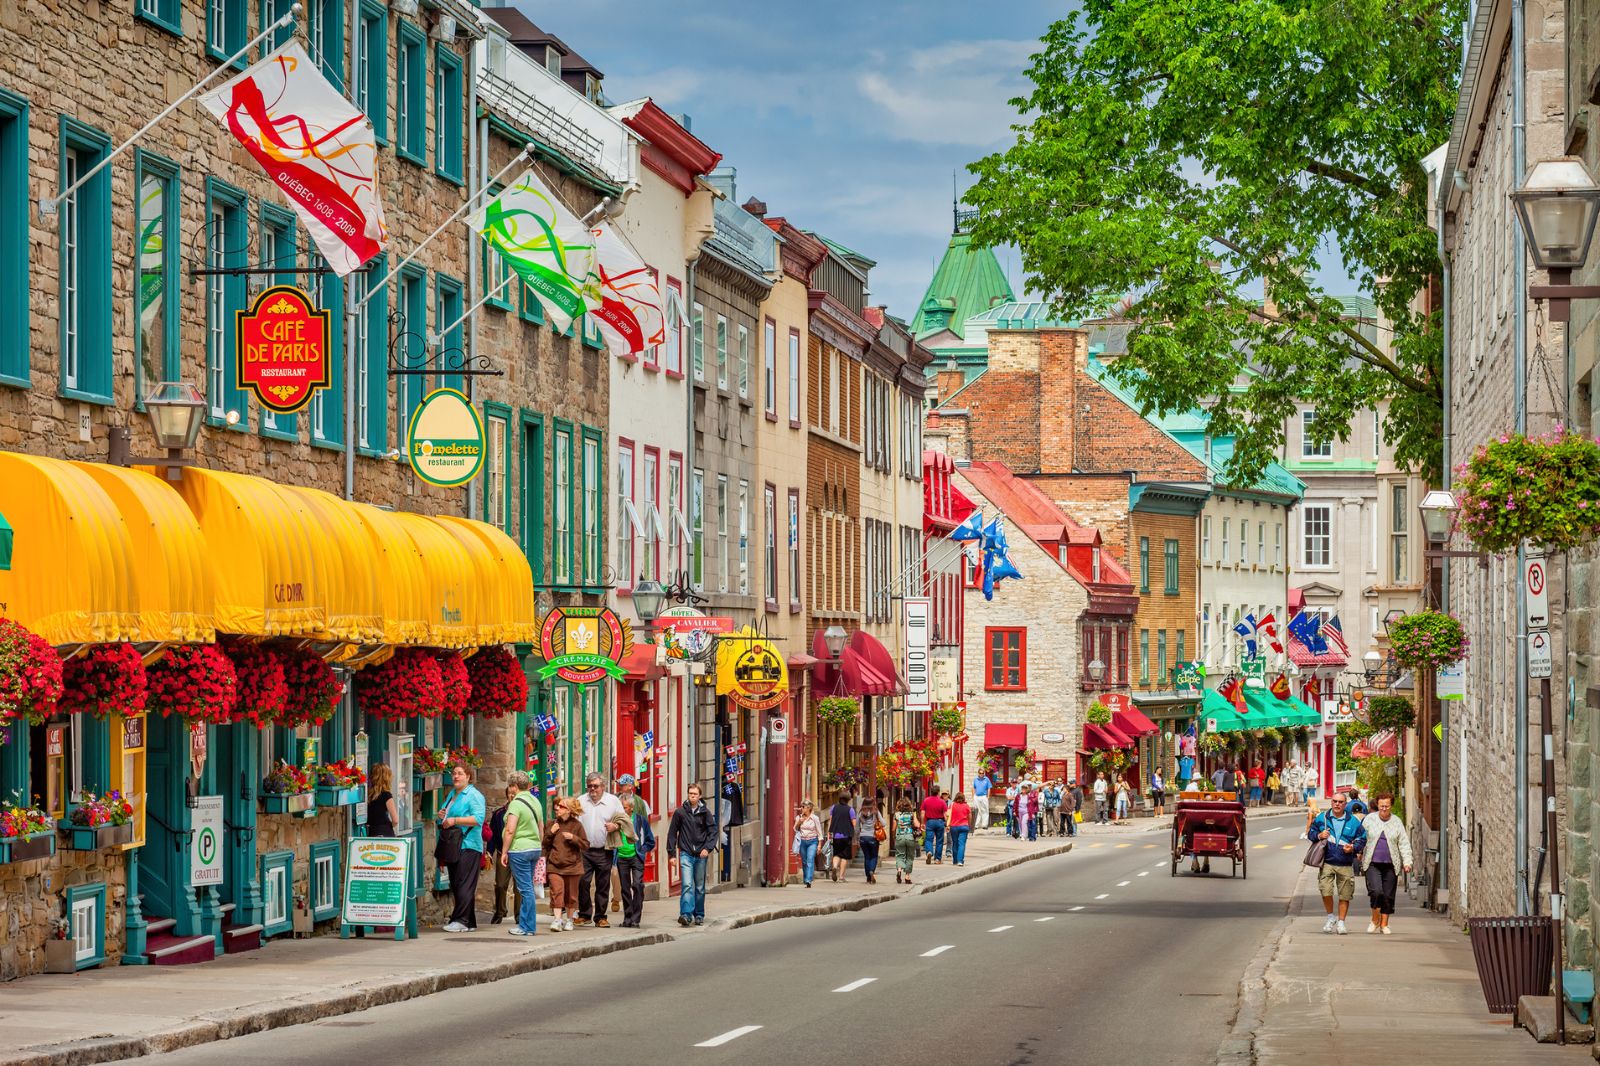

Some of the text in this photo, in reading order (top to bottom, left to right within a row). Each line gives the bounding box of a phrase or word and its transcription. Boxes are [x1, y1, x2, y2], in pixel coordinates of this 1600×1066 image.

[278, 172, 314, 202] QUÉBEC
[527, 274, 555, 294] QUÉBEC
[246, 343, 320, 363] DE PARIS
[261, 368, 307, 377] RESTAURANT
[428, 458, 465, 466] restaurant
[565, 607, 597, 616] MAISON
[677, 619, 717, 627] CAVALIER
[563, 671, 600, 680] SOUVENIRS
[731, 691, 739, 700] LA
[738, 697, 758, 708] PORTE
[204, 834, 212, 857] P
[194, 868, 220, 880] GRATUIT
